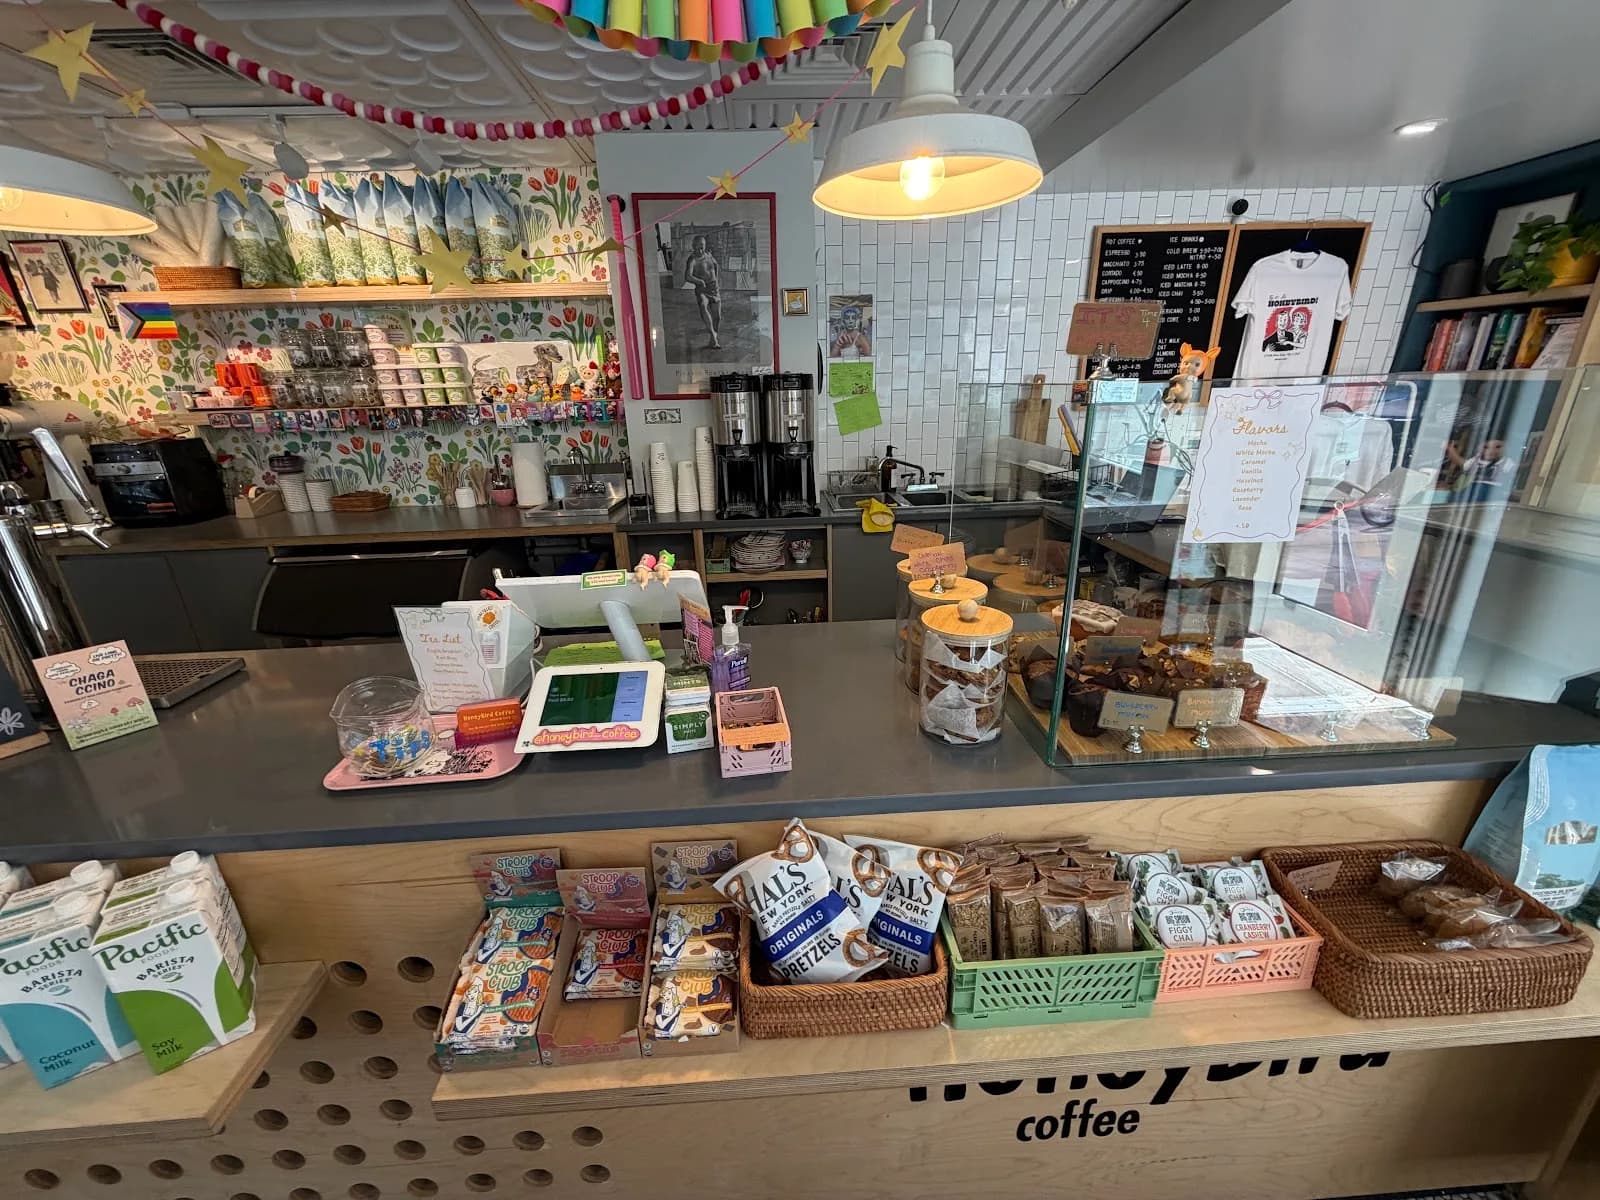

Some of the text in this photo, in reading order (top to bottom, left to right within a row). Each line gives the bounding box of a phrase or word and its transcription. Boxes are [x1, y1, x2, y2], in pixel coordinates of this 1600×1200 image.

[1232, 416, 1288, 435] Flavors
[69, 669, 115, 688] CHAGA
[75, 678, 116, 696] CCINO
[673, 721, 704, 730] SIMPLY
[676, 847, 712, 858] STROOP
[496, 856, 534, 868] STROOP
[682, 858, 706, 868] CLUB
[504, 868, 530, 876] CLUB
[583, 872, 619, 884] STROOP
[590, 883, 615, 892] CLUB
[760, 882, 811, 924] EW YORK
[1156, 888, 1178, 904] FIGGY
[506, 907, 549, 918] STROOP
[900, 899, 930, 918] YORK
[508, 916, 538, 930] CLUB
[686, 912, 716, 925] CLUB
[596, 930, 638, 941] STROOP
[770, 909, 824, 956] ORIGINALS
[1168, 926, 1193, 934] FIGGY
[92, 922, 208, 970] Pacific
[600, 939, 630, 953] CLUB
[782, 932, 842, 979] PRETZELS
[136, 956, 195, 981] BARISTA
[152, 964, 183, 978] SERIES
[486, 960, 532, 977] STROOP
[20, 969, 83, 993] BARISTA
[38, 978, 70, 991] SERIES
[489, 975, 522, 992] CLUB
[681, 980, 712, 994] CLUB
[152, 1037, 176, 1051] Soy
[156, 1042, 183, 1058] Milk
[39, 1038, 97, 1066] Coconut
[44, 1057, 73, 1073] Milk
[1016, 1098, 1140, 1142] coffee
